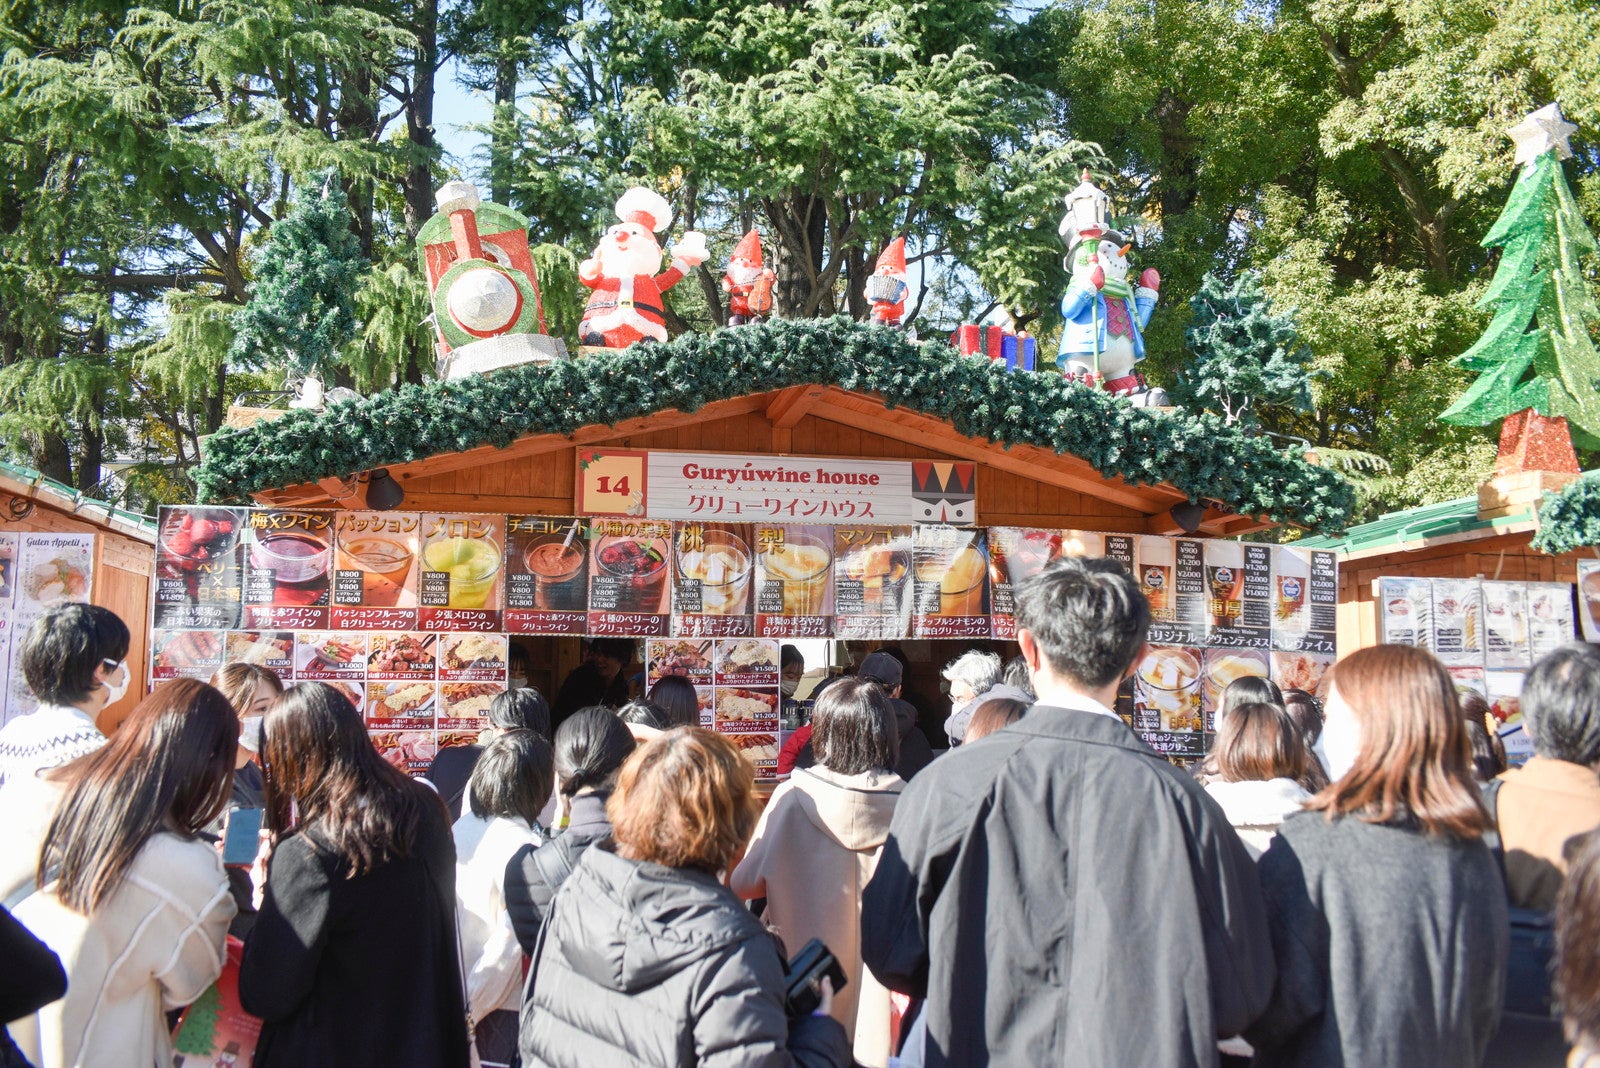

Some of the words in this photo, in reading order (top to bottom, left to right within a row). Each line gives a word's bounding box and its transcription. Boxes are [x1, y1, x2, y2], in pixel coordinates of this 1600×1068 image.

[682, 462, 811, 484] Guryúwine
[817, 468, 880, 486] house
[596, 476, 630, 496] 14
[688, 494, 874, 518] グリューワインハウス
[338, 514, 419, 533] パッション
[425, 517, 493, 539] メロン
[509, 519, 588, 535] チョコレート
[594, 521, 672, 540] 4種の果実
[26, 537, 50, 548] Guten
[52, 537, 81, 549] Appetit
[679, 525, 705, 553] 桃
[758, 528, 786, 555] 梨
[1248, 552, 1265, 560] ¥900
[197, 561, 241, 574] ベリー
[197, 587, 241, 602] 日本酒
[595, 589, 614, 597] ¥800
[1211, 598, 1242, 617] 重厚
[334, 609, 415, 619] パッションフルーツの
[434, 610, 487, 620] 夕張メロンの
[506, 612, 586, 622] チョコレートと赤ワインの
[599, 614, 660, 625] 4種のベリーの
[255, 618, 317, 627] グリューワイン
[340, 618, 407, 629] 白グリューワイン
[425, 620, 495, 631] 白グリューワイン
[521, 623, 570, 631] グリューワイン
[766, 617, 824, 626] 洋梨のまろやか
[919, 617, 985, 627] アップルシナモンの
[993, 617, 1017, 627] いちご
[598, 624, 659, 634] グリューワイン
[681, 626, 747, 635] 白グリューワイン
[763, 626, 827, 636] 白グリューワイン
[1207, 634, 1270, 647] アヴェンティヌス
[1169, 716, 1202, 730] 日本酒
[1149, 742, 1196, 752] 本酒グリュー
